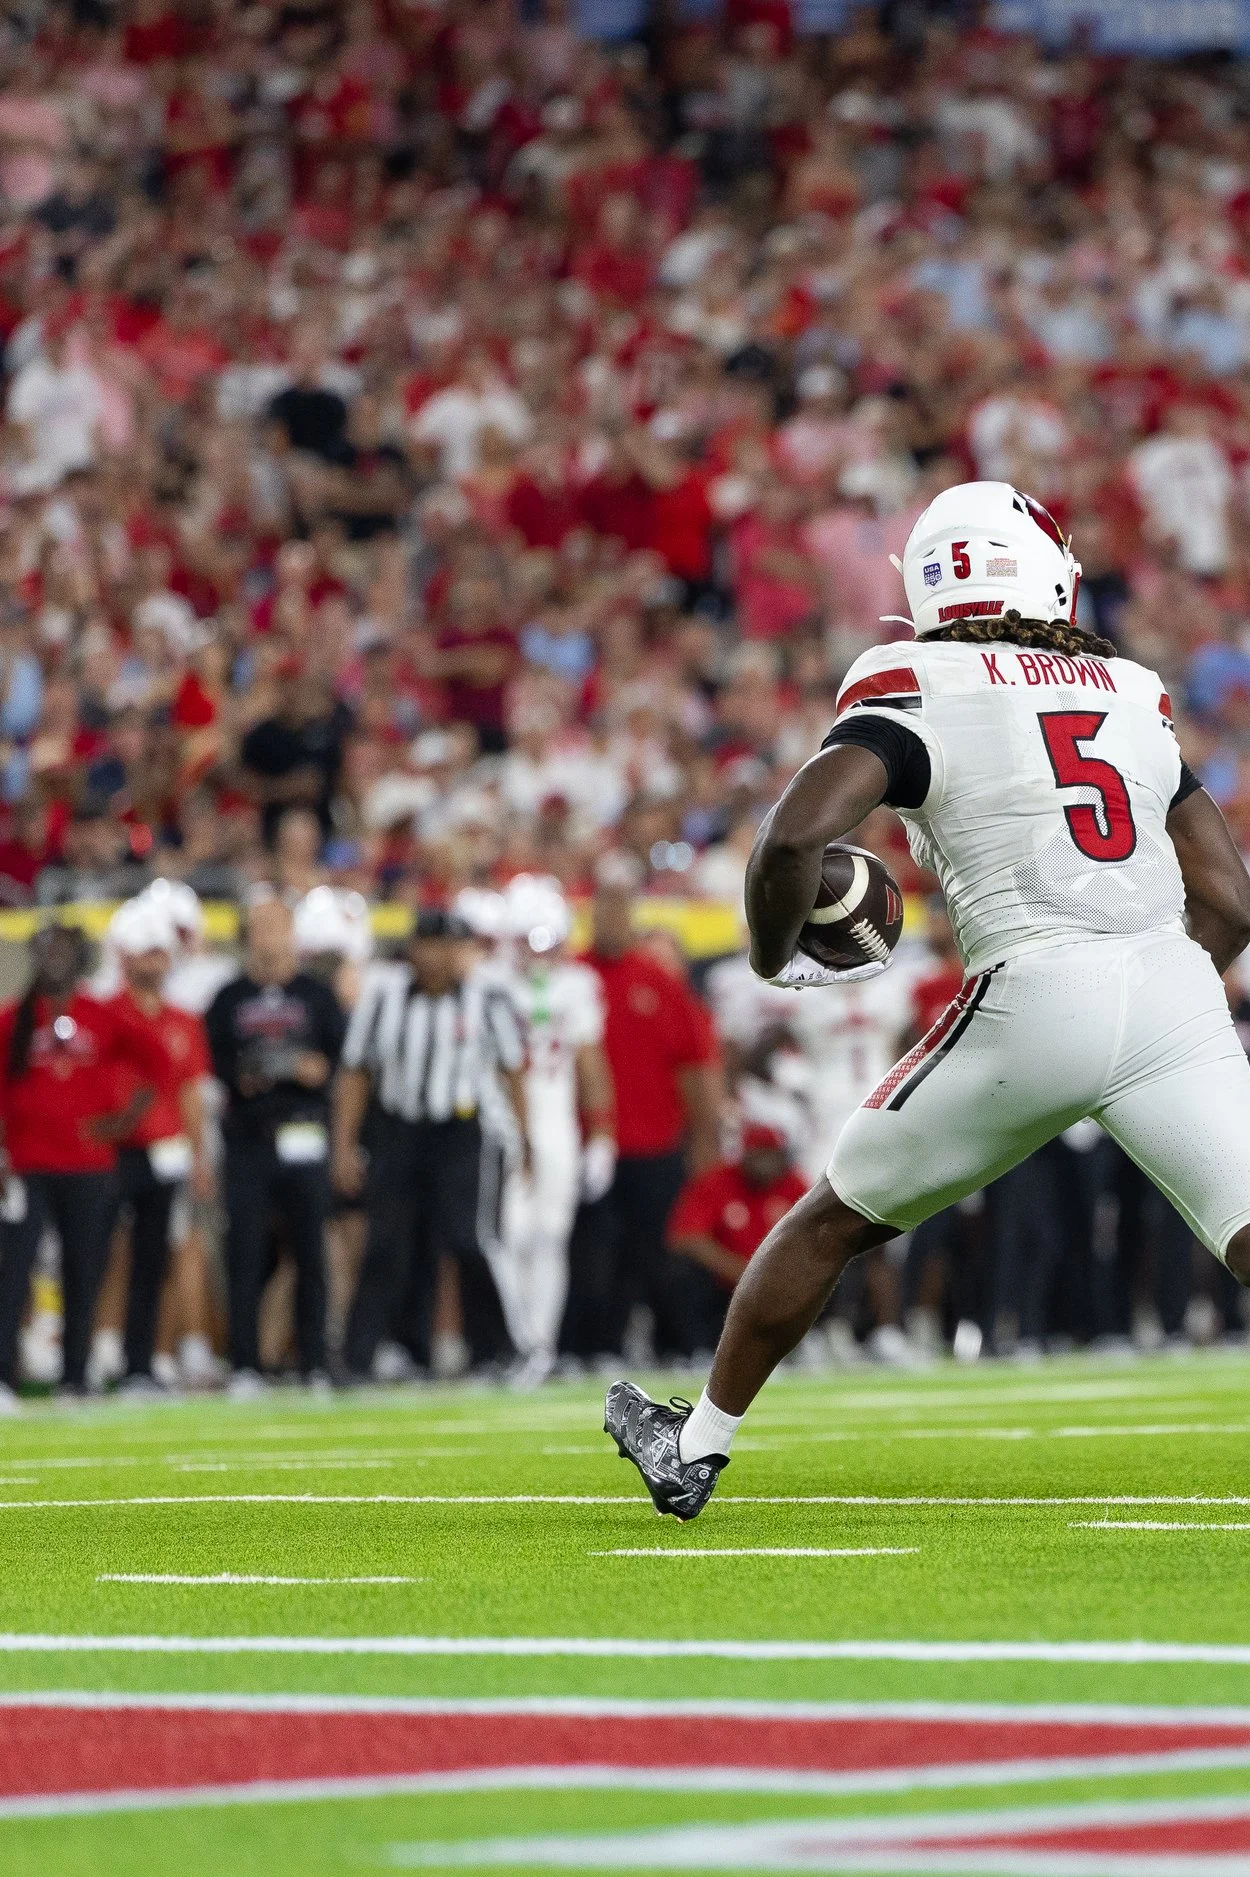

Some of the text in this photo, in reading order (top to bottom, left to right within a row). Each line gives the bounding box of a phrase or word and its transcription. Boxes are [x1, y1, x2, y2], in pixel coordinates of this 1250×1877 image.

[924, 564, 940, 574] USA
[951, 541, 972, 580] 5
[938, 600, 1005, 624] LOUISVILLE
[981, 653, 1118, 693] K. BROWN
[1036, 710, 1137, 862] 5
